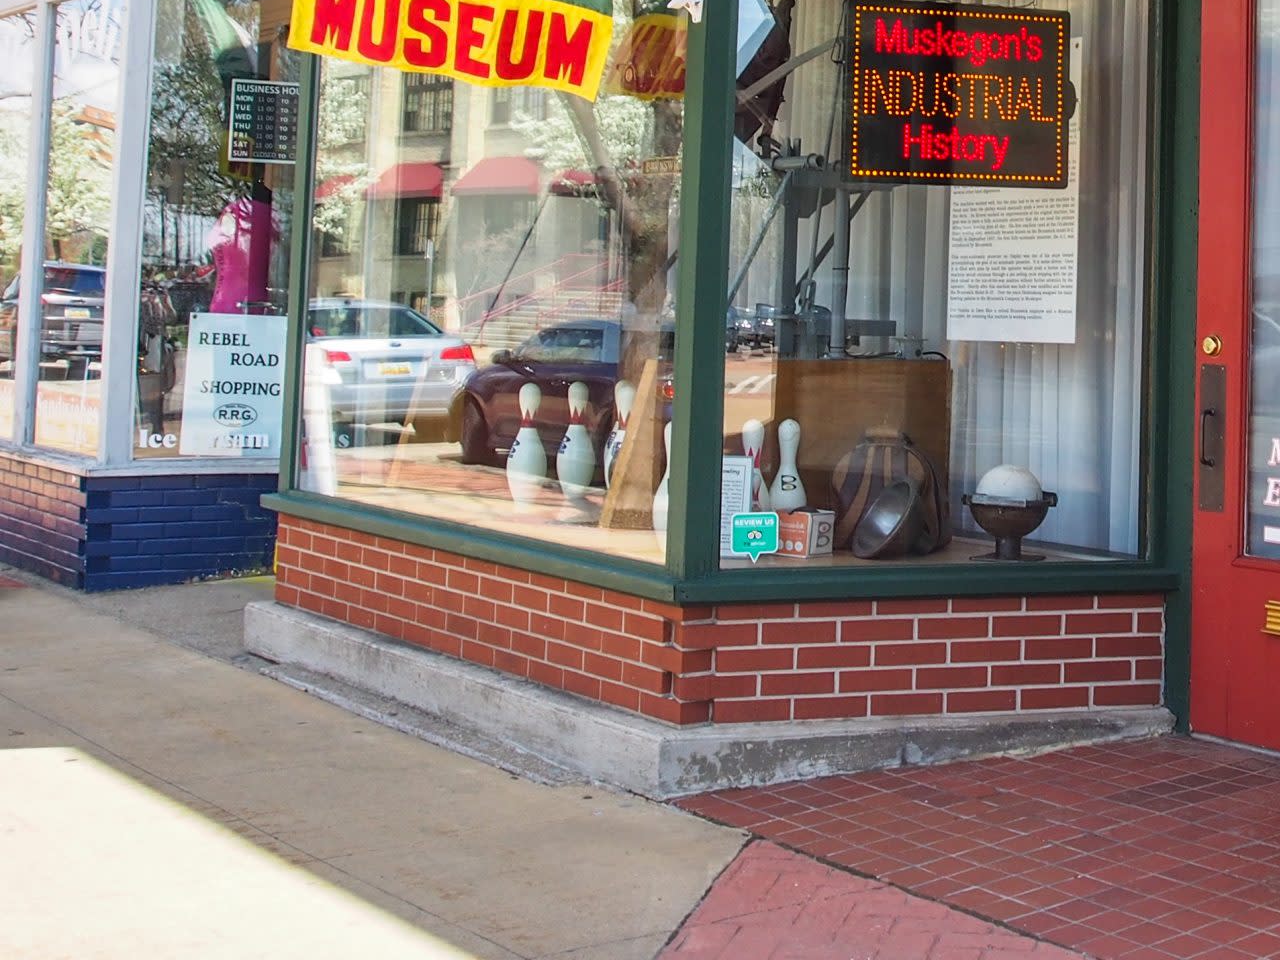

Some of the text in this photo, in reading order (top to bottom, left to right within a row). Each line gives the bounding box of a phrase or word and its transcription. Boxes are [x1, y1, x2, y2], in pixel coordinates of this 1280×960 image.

[875, 16, 1044, 67] Muskegon's
[236, 84, 281, 95] BUSINESS
[864, 68, 1055, 122] INDUSTRIAL
[903, 122, 1011, 171] History
[199, 331, 250, 347] REBEL
[230, 352, 280, 367] ROAD
[200, 380, 281, 397] SHOPPING
[218, 409, 254, 421] R.R.G.
[138, 428, 178, 449] Ice
